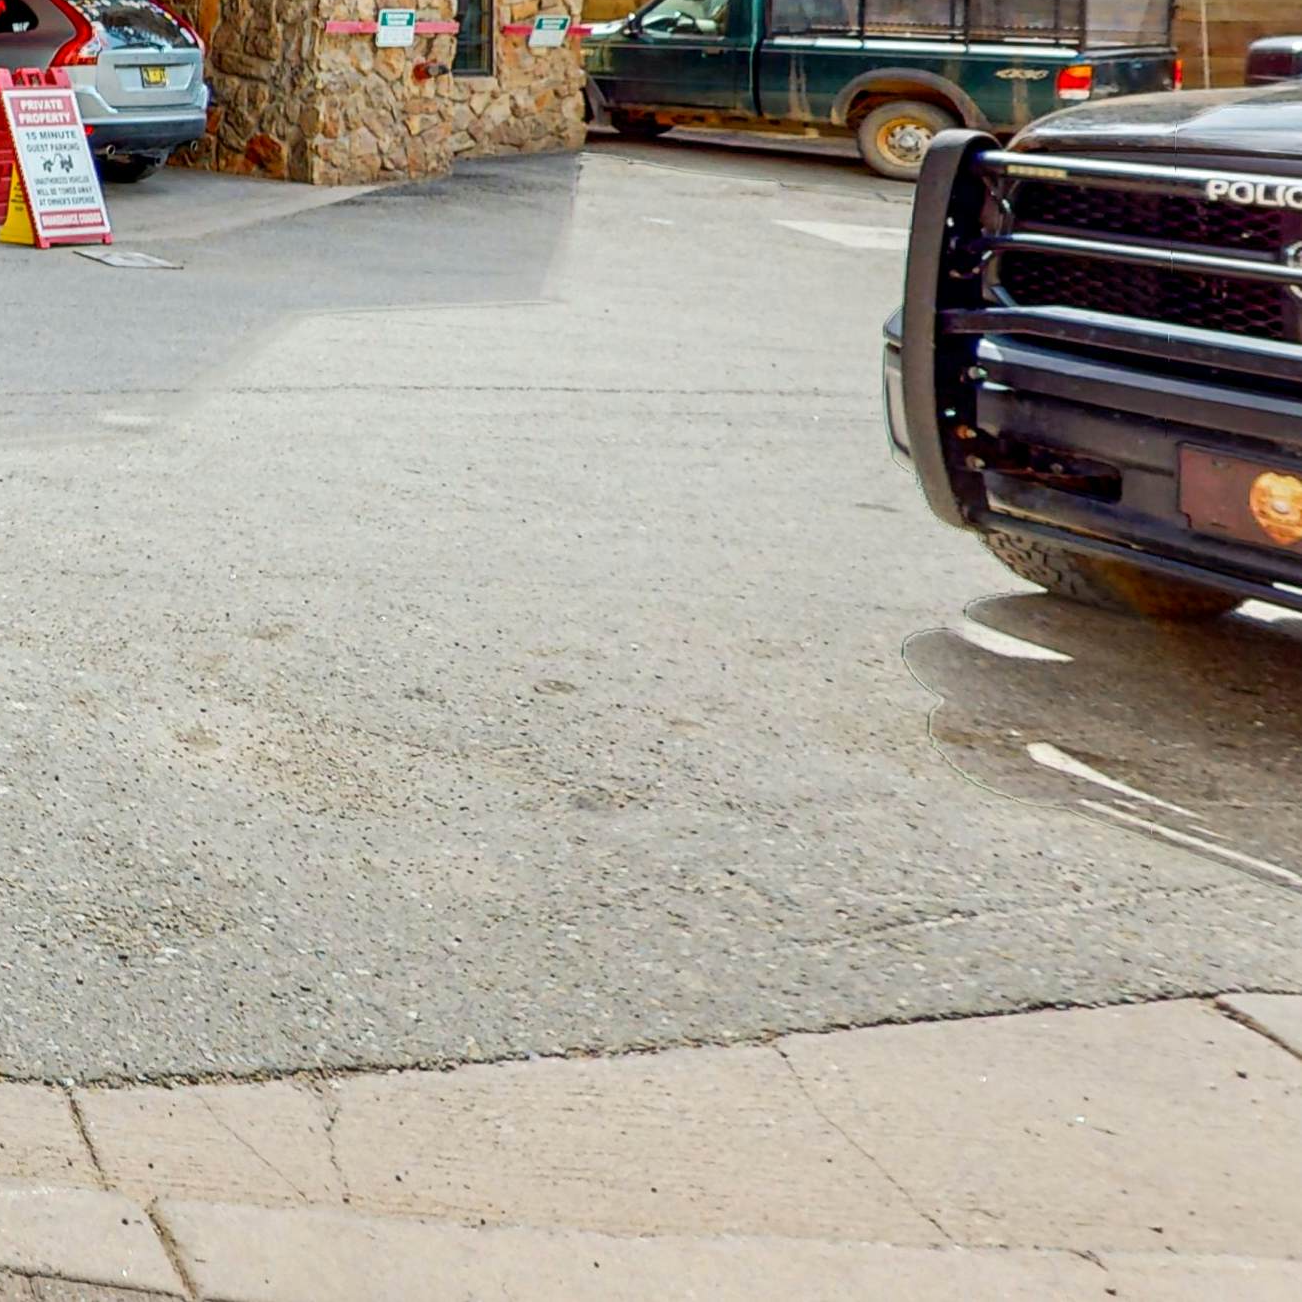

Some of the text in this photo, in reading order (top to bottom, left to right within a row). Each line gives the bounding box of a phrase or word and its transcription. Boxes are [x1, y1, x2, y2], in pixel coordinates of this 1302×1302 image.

[20, 98, 64, 111] PRIVATE
[18, 112, 70, 125] PROPERTY
[25, 130, 77, 140] 15 MINUTE
[26, 142, 80, 153] GUEST PARKING
